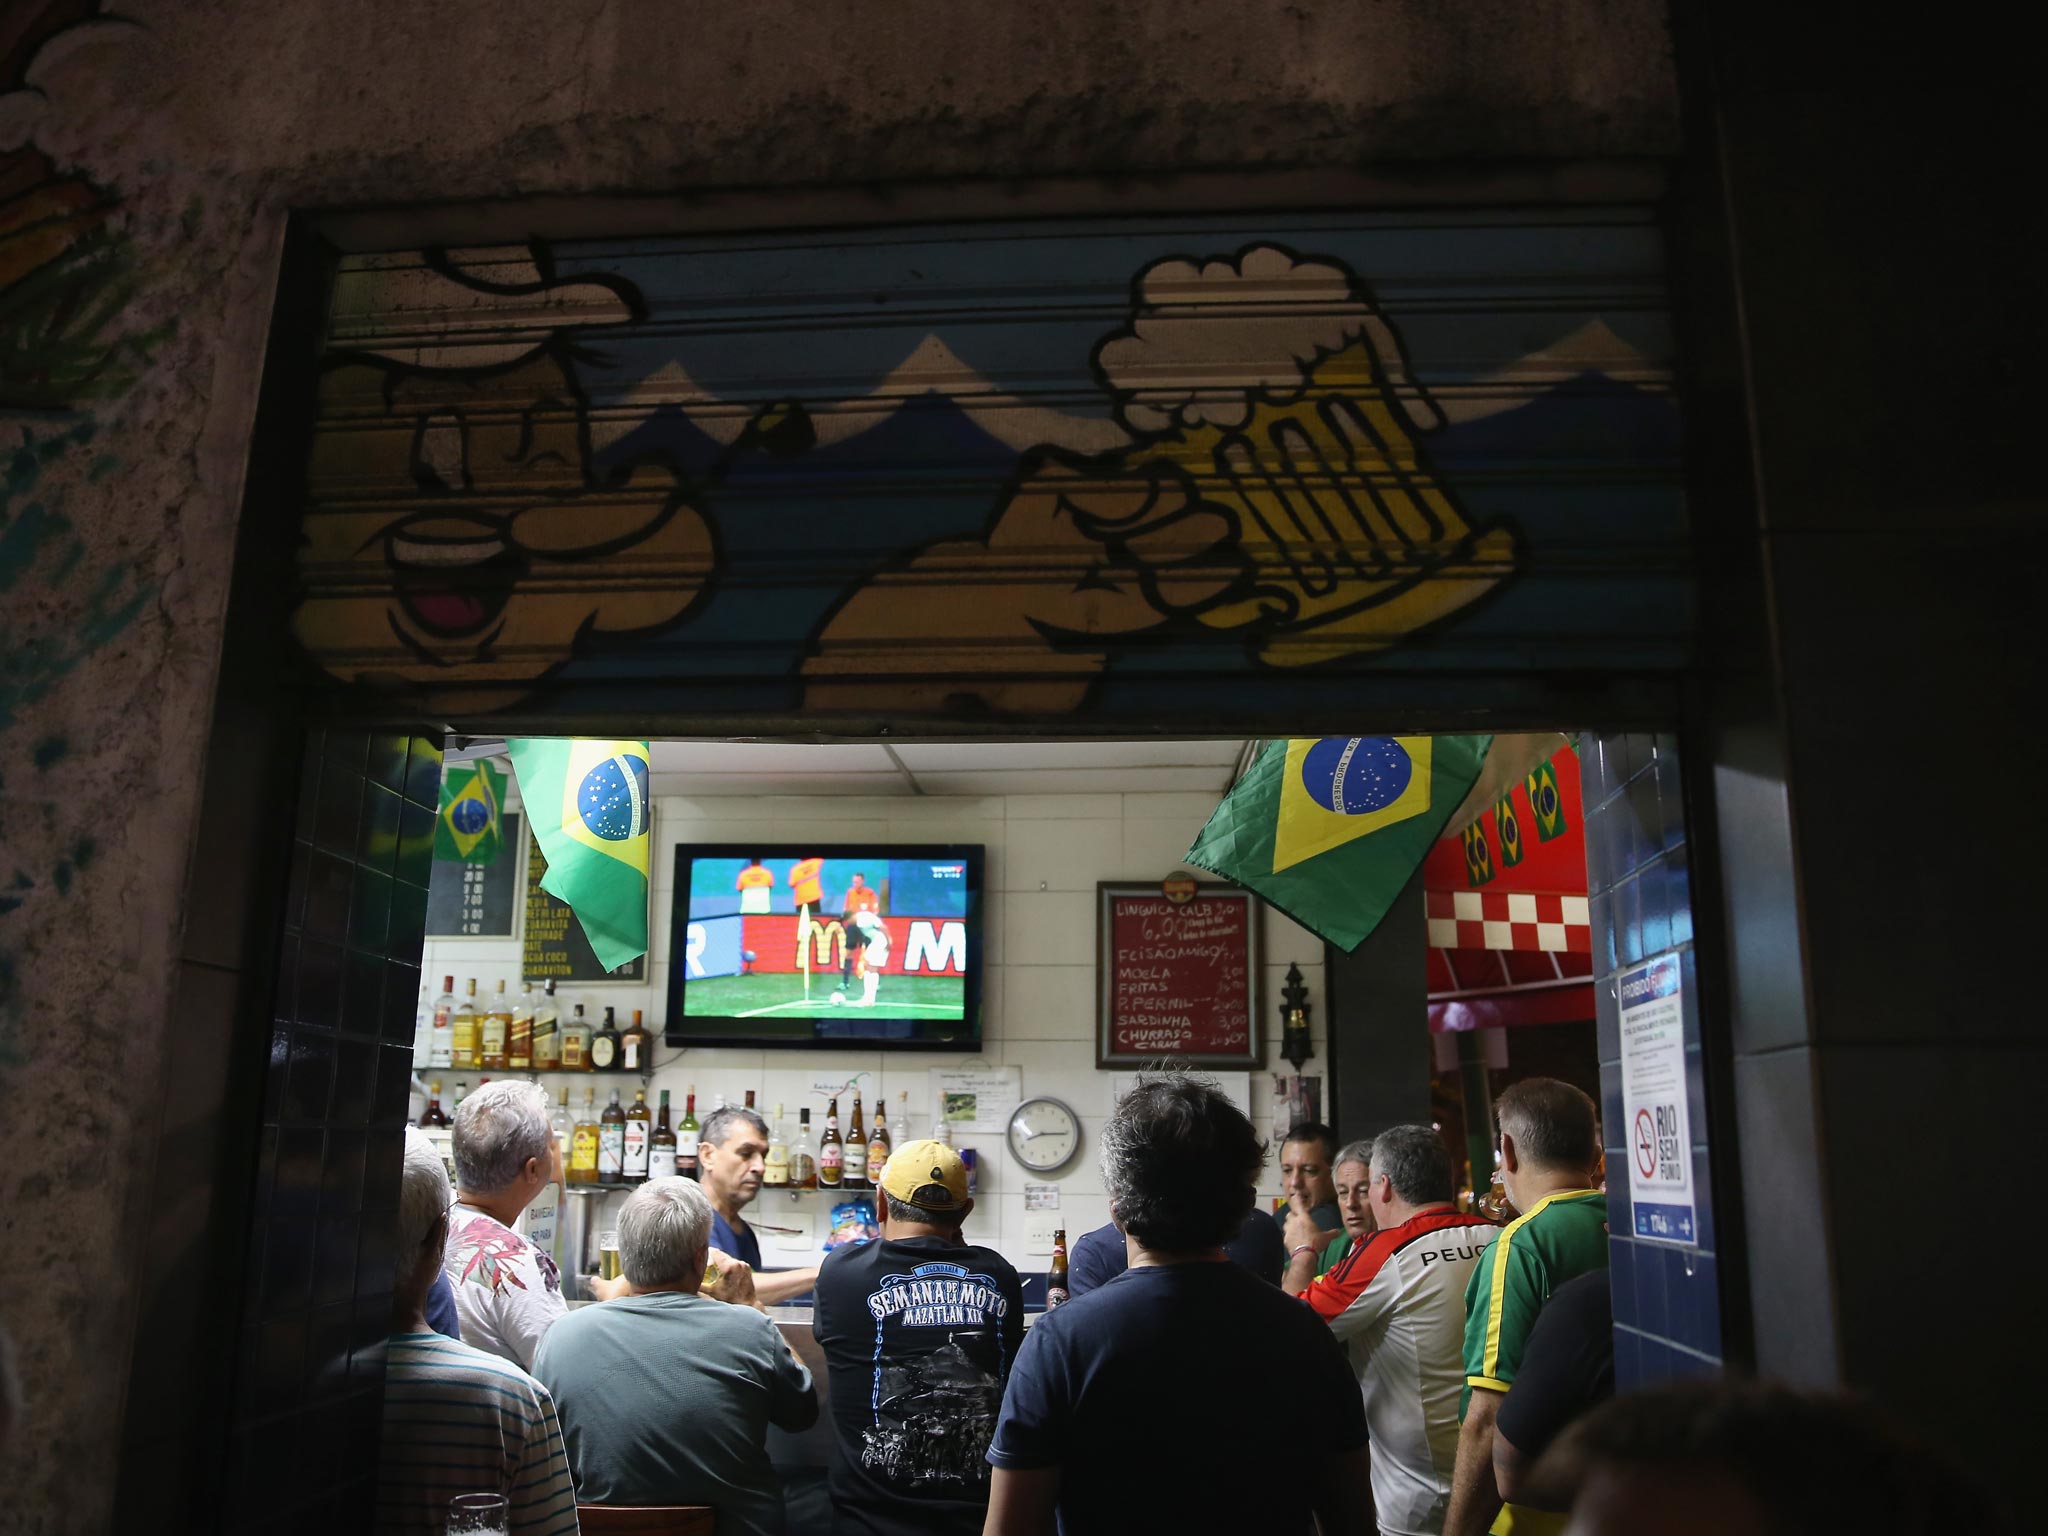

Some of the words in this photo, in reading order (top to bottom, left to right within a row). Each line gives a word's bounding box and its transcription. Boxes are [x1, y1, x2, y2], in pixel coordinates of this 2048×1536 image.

[631, 787, 641, 836] PROGRESSO
[1119, 982, 1169, 995] FRITAS
[1132, 998, 1194, 1011] PERNIL
[1117, 1014, 1192, 1028] SARDINHA
[1134, 1040, 1181, 1050] CARNE
[1656, 1105, 1676, 1137] RIO
[1658, 1138, 1680, 1161] SEM
[1660, 1163, 1681, 1180] FUMO
[921, 1263, 959, 1275] LEGENDARIA
[946, 1282, 957, 1293] DE
[869, 1281, 943, 1318] SEMANA
[946, 1293, 957, 1304] LA
[959, 1282, 1007, 1317] MOTO
[903, 1305, 964, 1325] MAZATLAN
[966, 1307, 984, 1324] XIX
